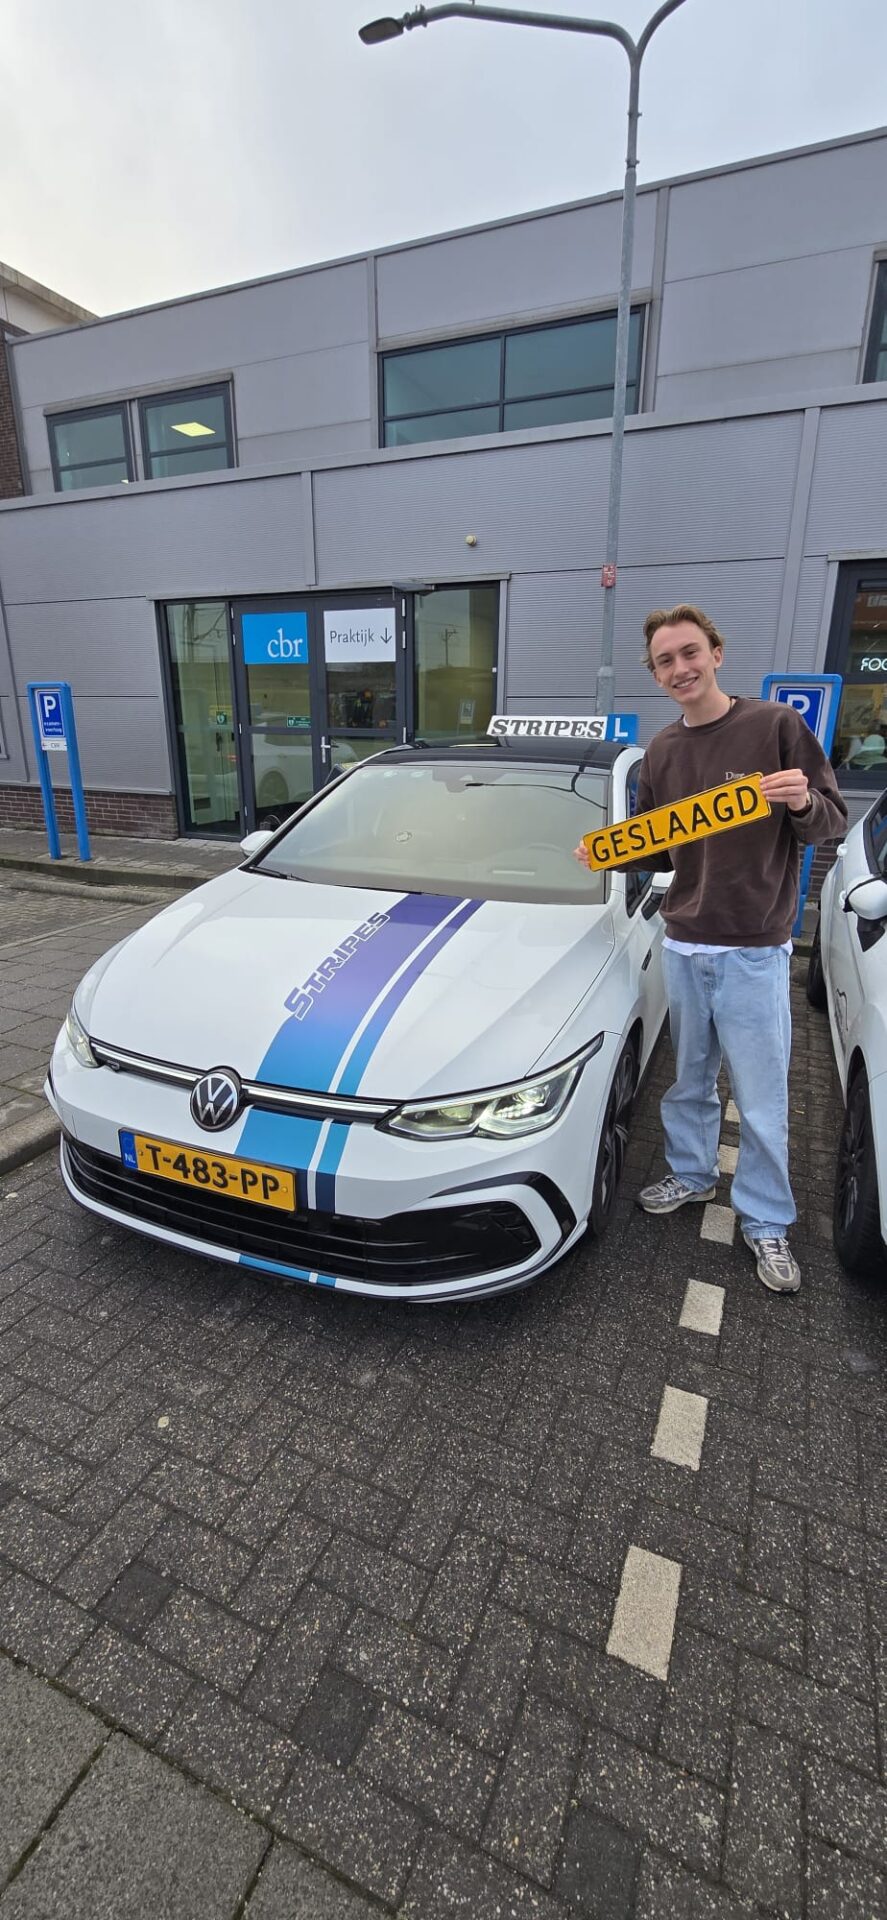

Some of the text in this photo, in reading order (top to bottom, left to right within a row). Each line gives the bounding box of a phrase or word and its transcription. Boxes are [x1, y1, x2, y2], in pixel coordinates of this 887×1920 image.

[267, 628, 303, 658] cbr
[330, 628, 375, 647] Praktijk
[43, 695, 57, 718] P
[491, 718, 629, 738] STRIPES L
[591, 785, 759, 863] GESLAAGD
[124, 1153, 136, 1164] NL
[145, 1143, 280, 1200] T-483-PP
